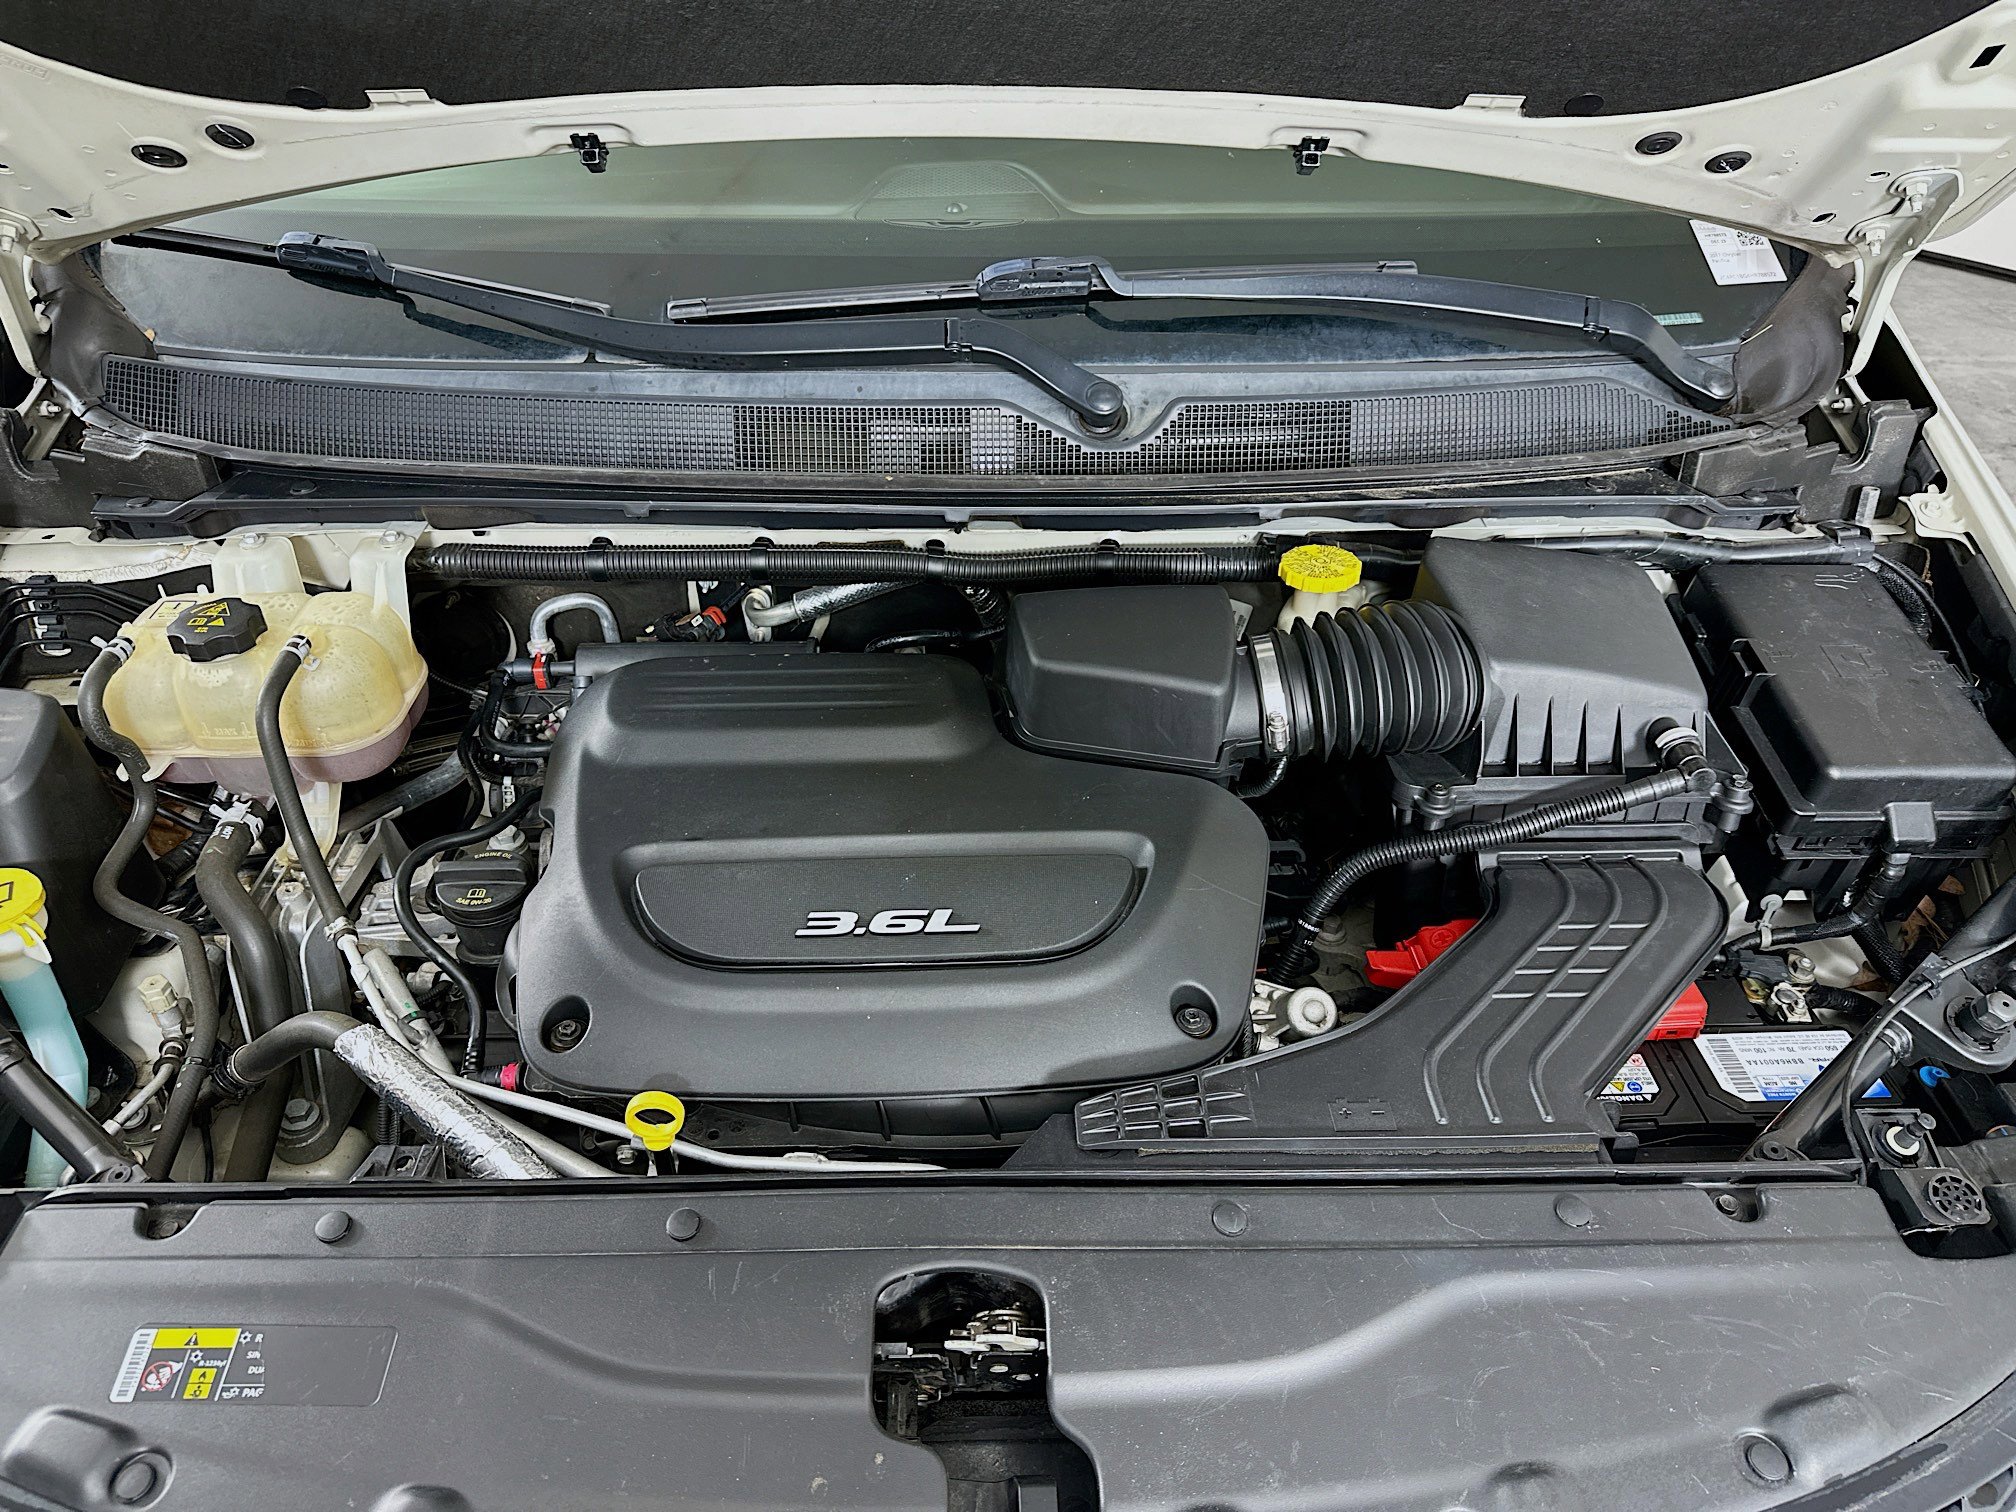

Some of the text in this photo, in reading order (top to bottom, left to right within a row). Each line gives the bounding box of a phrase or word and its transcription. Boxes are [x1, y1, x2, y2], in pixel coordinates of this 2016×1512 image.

[474, 851, 502, 859] ENGINE
[455, 897, 471, 905] SAE
[794, 908, 981, 938] 3.6L
[254, 1333, 264, 1343] R
